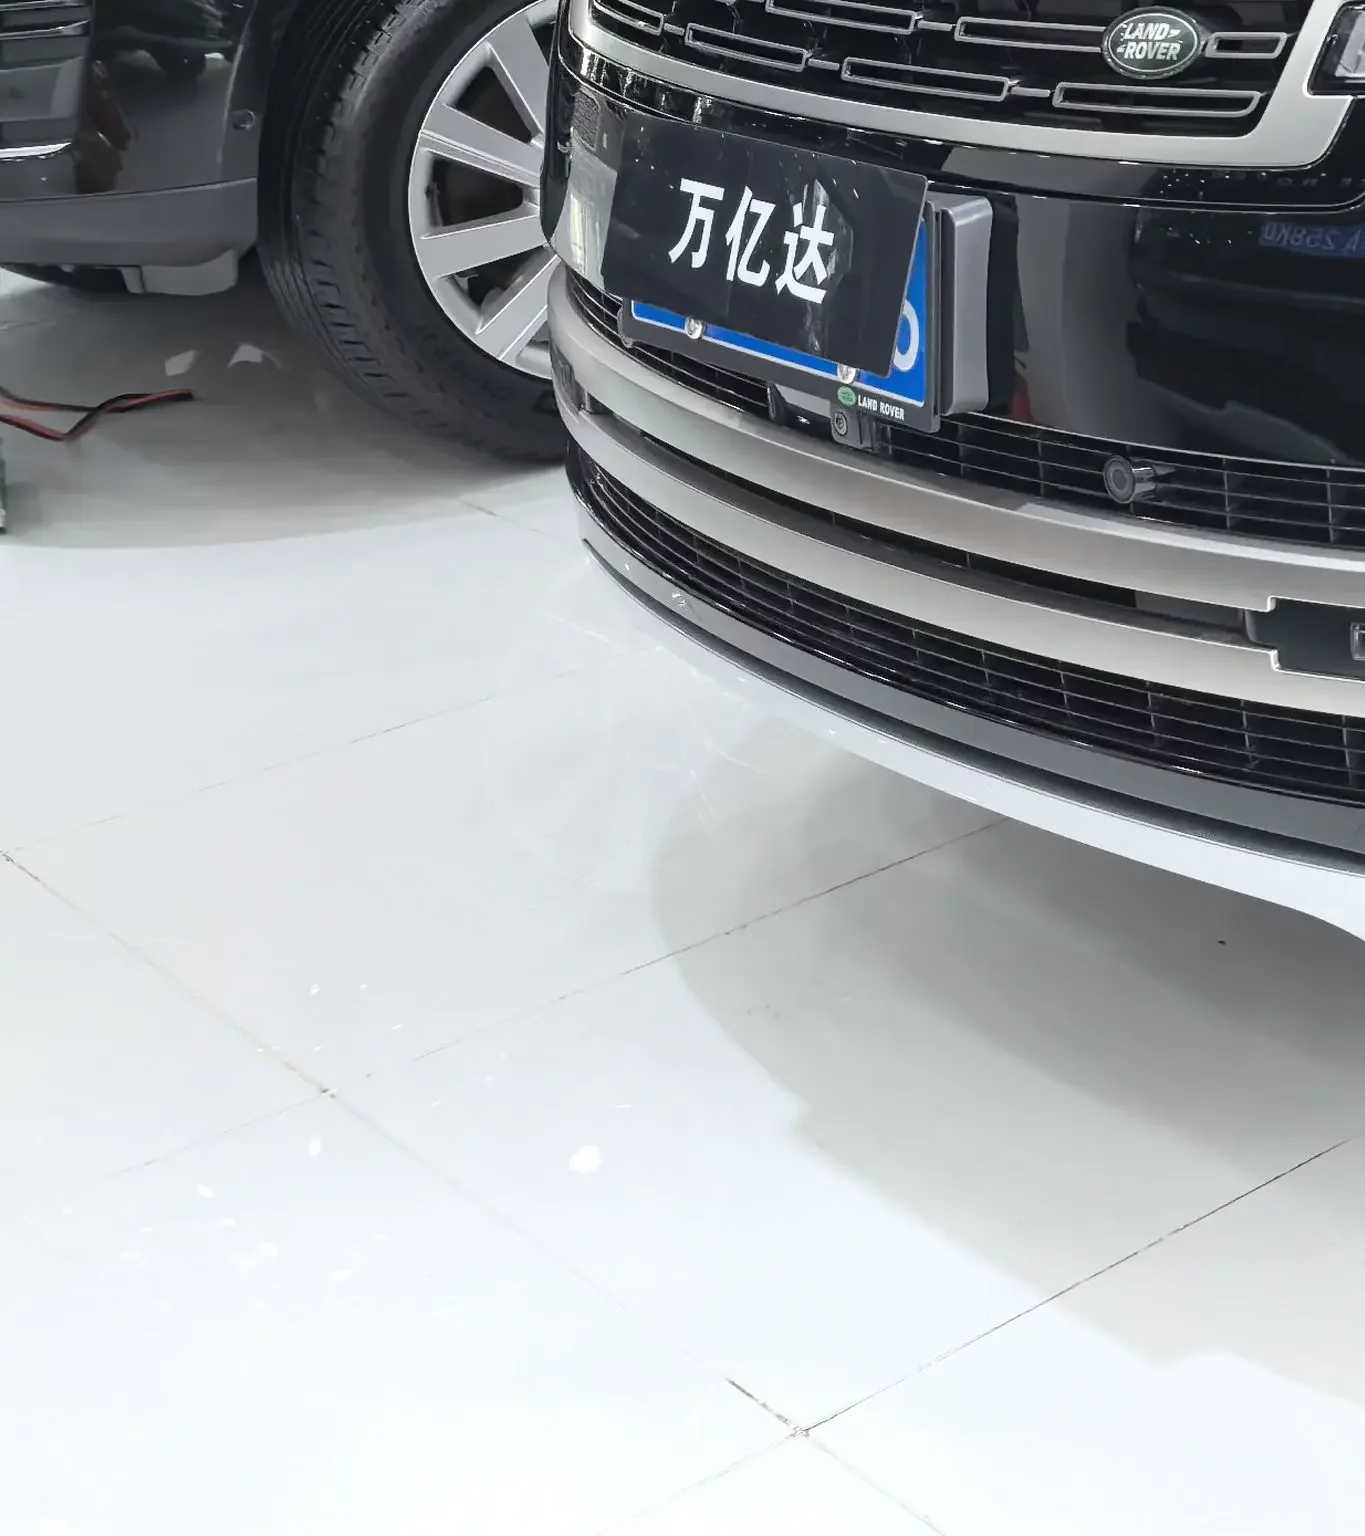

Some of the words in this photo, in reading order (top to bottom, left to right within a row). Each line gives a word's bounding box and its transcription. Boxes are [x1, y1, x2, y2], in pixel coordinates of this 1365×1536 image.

[1123, 23, 1170, 40] LAND
[1124, 41, 1181, 60] ROVER
[668, 177, 835, 304] 万亿达
[858, 395, 878, 412] LAND
[880, 402, 905, 421] ROVER
